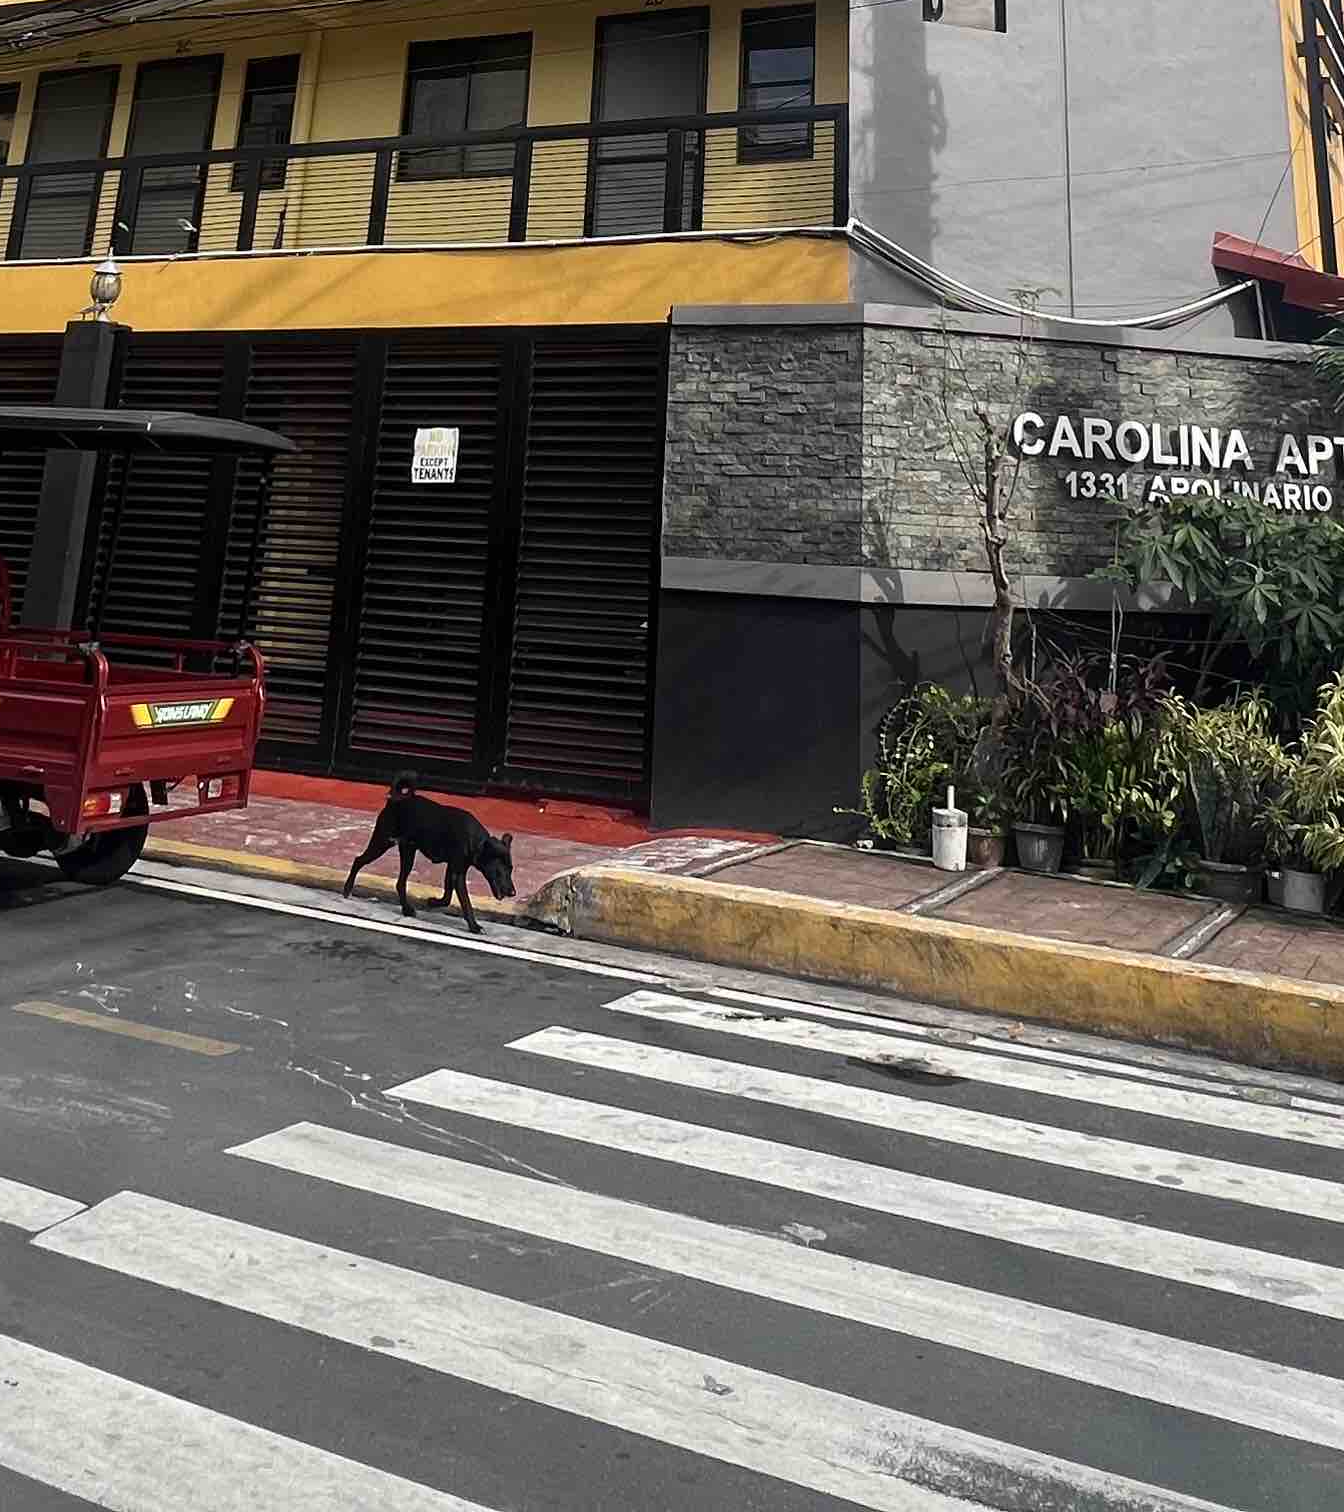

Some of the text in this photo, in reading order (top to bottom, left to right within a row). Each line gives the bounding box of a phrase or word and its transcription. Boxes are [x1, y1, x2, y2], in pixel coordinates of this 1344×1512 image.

[1013, 411, 1255, 471] CAROLINA
[414, 468, 454, 480] TENANTS
[1065, 470, 1129, 500] 1331
